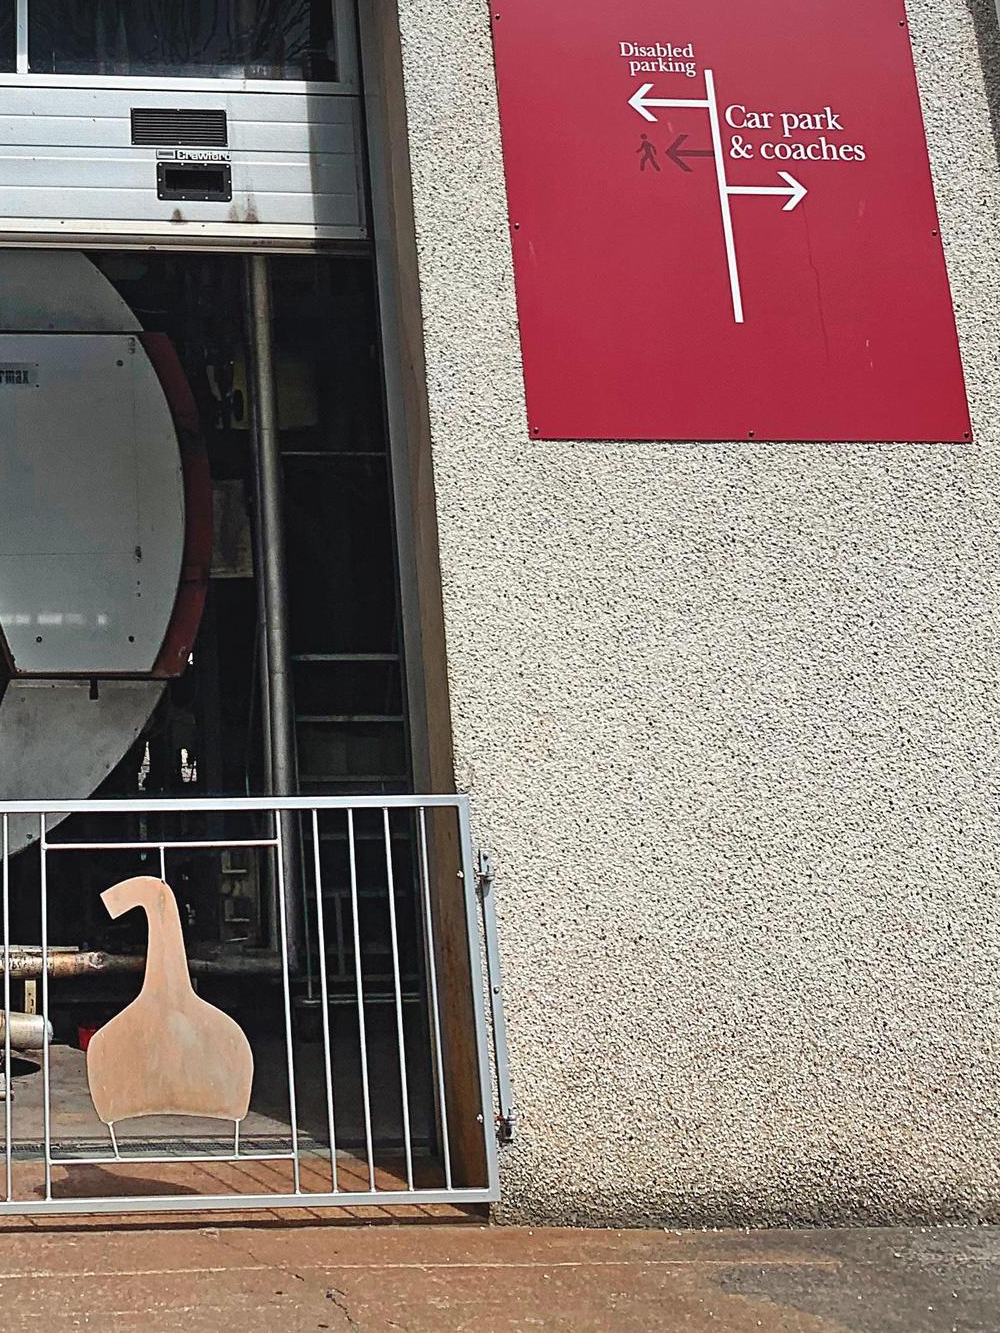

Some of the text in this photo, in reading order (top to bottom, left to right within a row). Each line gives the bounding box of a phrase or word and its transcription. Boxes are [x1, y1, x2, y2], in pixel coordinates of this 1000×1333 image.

[619, 41, 695, 58] Disabled
[629, 57, 697, 78] parking
[725, 104, 844, 138] Car park
[729, 135, 866, 162] & coaches
